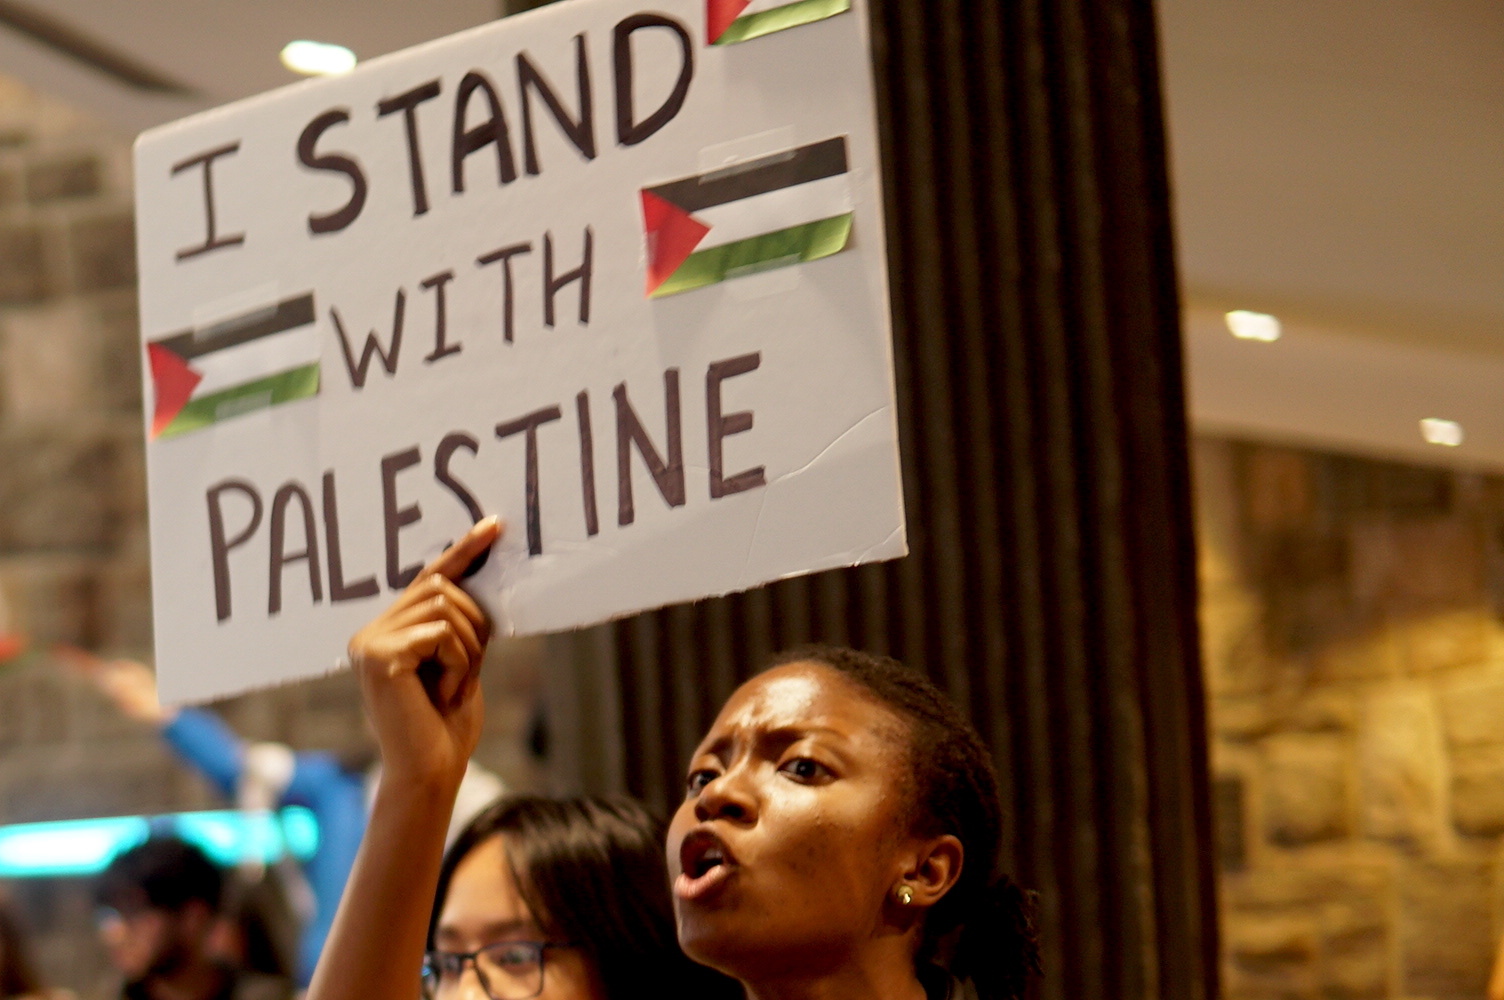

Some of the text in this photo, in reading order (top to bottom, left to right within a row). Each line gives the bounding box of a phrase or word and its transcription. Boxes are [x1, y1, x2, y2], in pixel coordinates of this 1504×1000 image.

[169, 13, 695, 262] I STAND
[330, 225, 594, 389] WITH
[206, 352, 768, 624] PALESTINE
